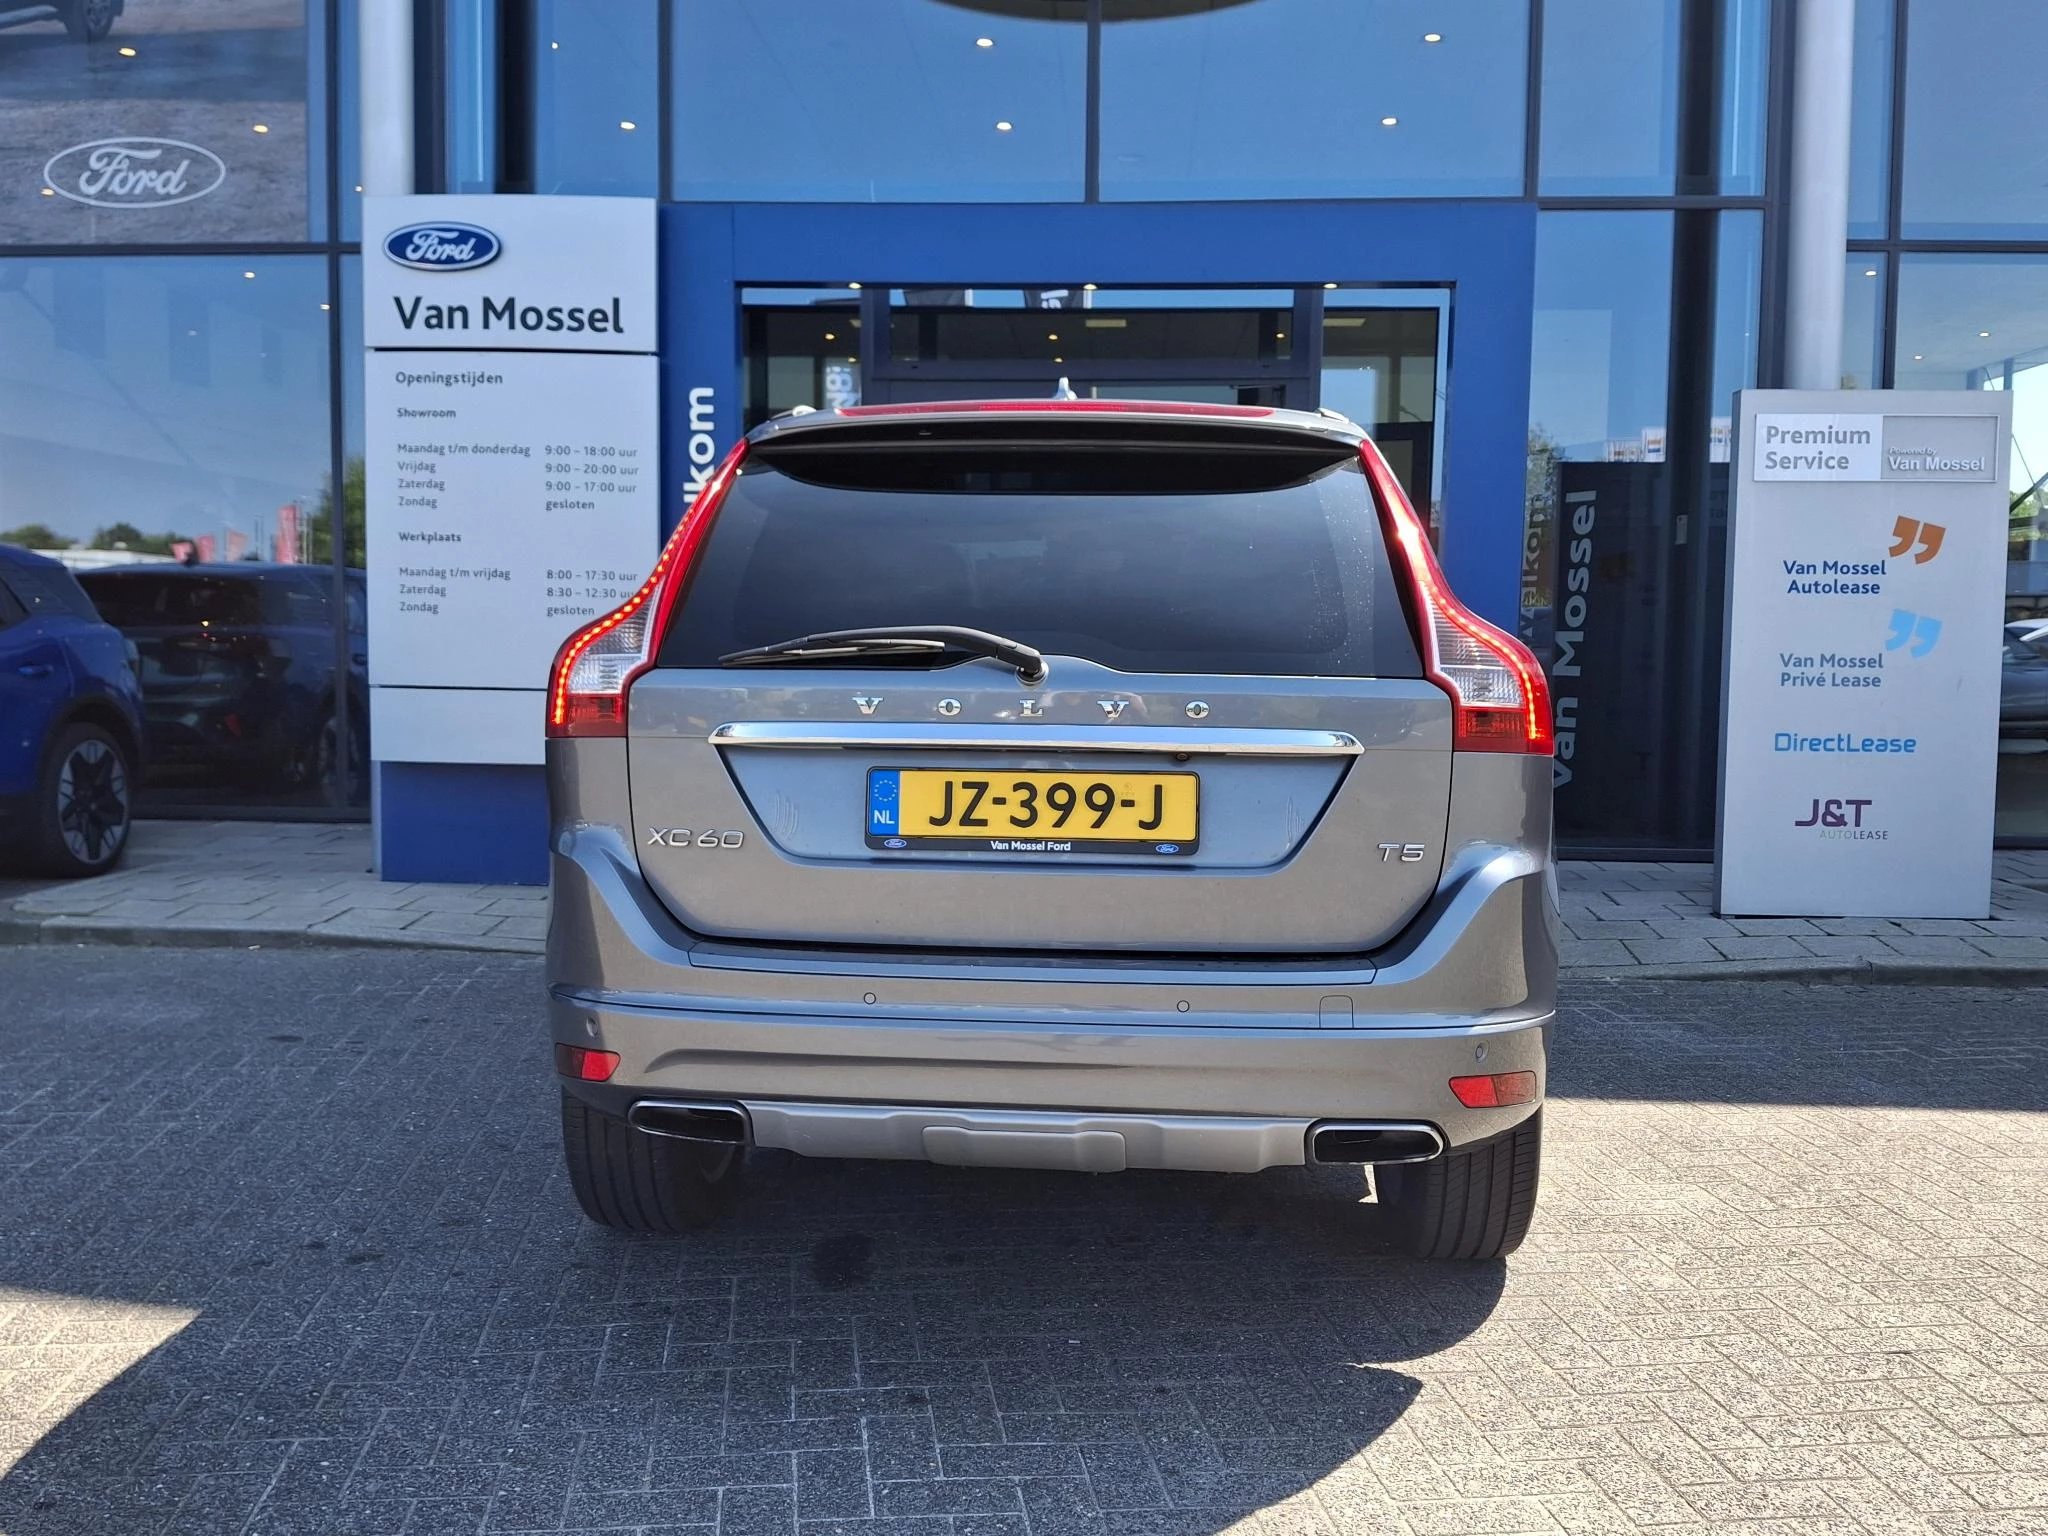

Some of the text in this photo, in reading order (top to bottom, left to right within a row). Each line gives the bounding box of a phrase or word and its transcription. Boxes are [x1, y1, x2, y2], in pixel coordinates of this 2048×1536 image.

[79, 147, 191, 196] Ford
[405, 229, 476, 261] Ford
[393, 296, 624, 333] Van Mossel
[395, 371, 503, 387] Openingstijden
[397, 408, 456, 418] Showroom
[1766, 425, 1871, 444] Premium
[397, 443, 446, 456] Maandag
[448, 444, 469, 455] t/m
[471, 444, 531, 457] donderdag
[545, 446, 572, 456] 9:00
[585, 446, 616, 457] 18:00
[618, 448, 638, 457] uur
[397, 461, 436, 474] Vrijdag
[545, 463, 572, 474] 9:00
[583, 464, 617, 475] 20:00
[620, 466, 639, 475] uur
[1765, 451, 1849, 470] Service
[1889, 456, 1985, 471] Van Mossel
[397, 479, 445, 492] Zaterdag
[545, 481, 572, 492] 9:00
[585, 482, 615, 493] 17:00
[618, 484, 637, 493] uur
[398, 496, 595, 511] Zondag gesloten
[398, 532, 462, 544] Werkplaats
[399, 567, 447, 580] Maandag
[450, 567, 470, 578] t/m
[473, 568, 511, 581] vrijdag
[546, 569, 572, 580] 8:00
[585, 570, 616, 581] 17:30
[618, 573, 638, 581] uur
[1783, 560, 1887, 576] Van Mossel
[399, 585, 447, 597] Zaterdag
[546, 587, 572, 597] 8:30
[585, 588, 617, 598] 12:30
[1552, 489, 1597, 678] Mossel
[1787, 579, 1881, 595] Autolease
[399, 602, 595, 617] Zondag gesloten
[1779, 653, 1884, 669] Van Mossel
[1780, 672, 1881, 688] Privé Lease
[852, 697, 1210, 720] VOLVO
[1774, 732, 1917, 753] DirectLease
[929, 780, 1163, 831] JZ-399-J
[1794, 798, 1873, 828] J&T
[873, 810, 895, 825] NL
[1819, 830, 1888, 840] AUTOLEASE
[990, 840, 1071, 851] Van Mossel Ford
[1378, 842, 1425, 862] T5
